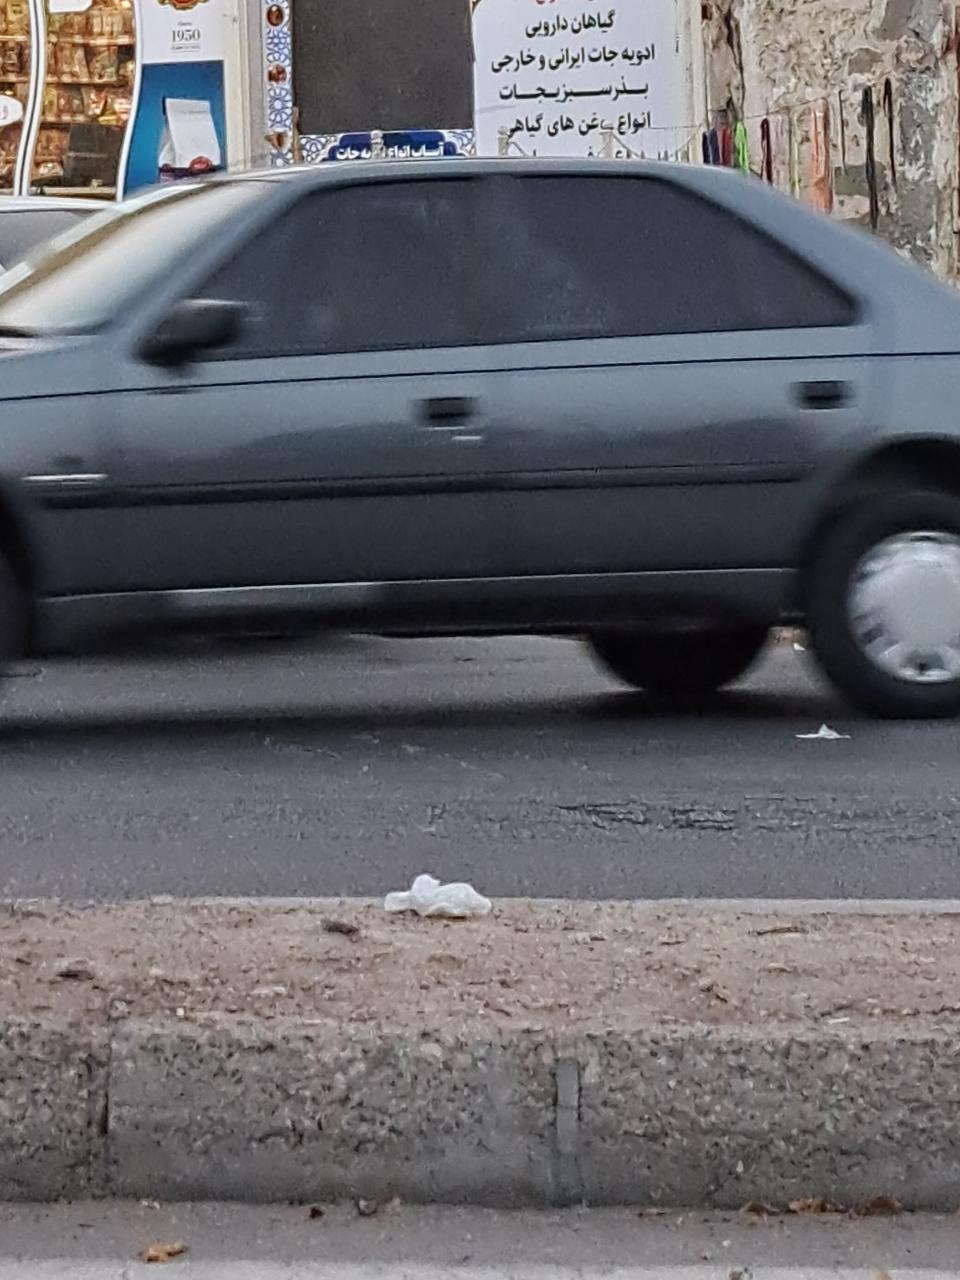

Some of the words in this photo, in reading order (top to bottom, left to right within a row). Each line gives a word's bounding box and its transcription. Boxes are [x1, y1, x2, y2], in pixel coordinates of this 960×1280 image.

[525, 14, 568, 38] دارویی
[571, 9, 616, 34] گیاهان
[171, 28, 201, 43] 1950
[491, 47, 536, 73] خارجی
[538, 54, 545, 70] و
[548, 46, 585, 70] ایرانی
[587, 47, 619, 66] جات
[622, 43, 656, 66] ادویه
[547, 114, 575, 137] های
[618, 110, 651, 136] انواع
